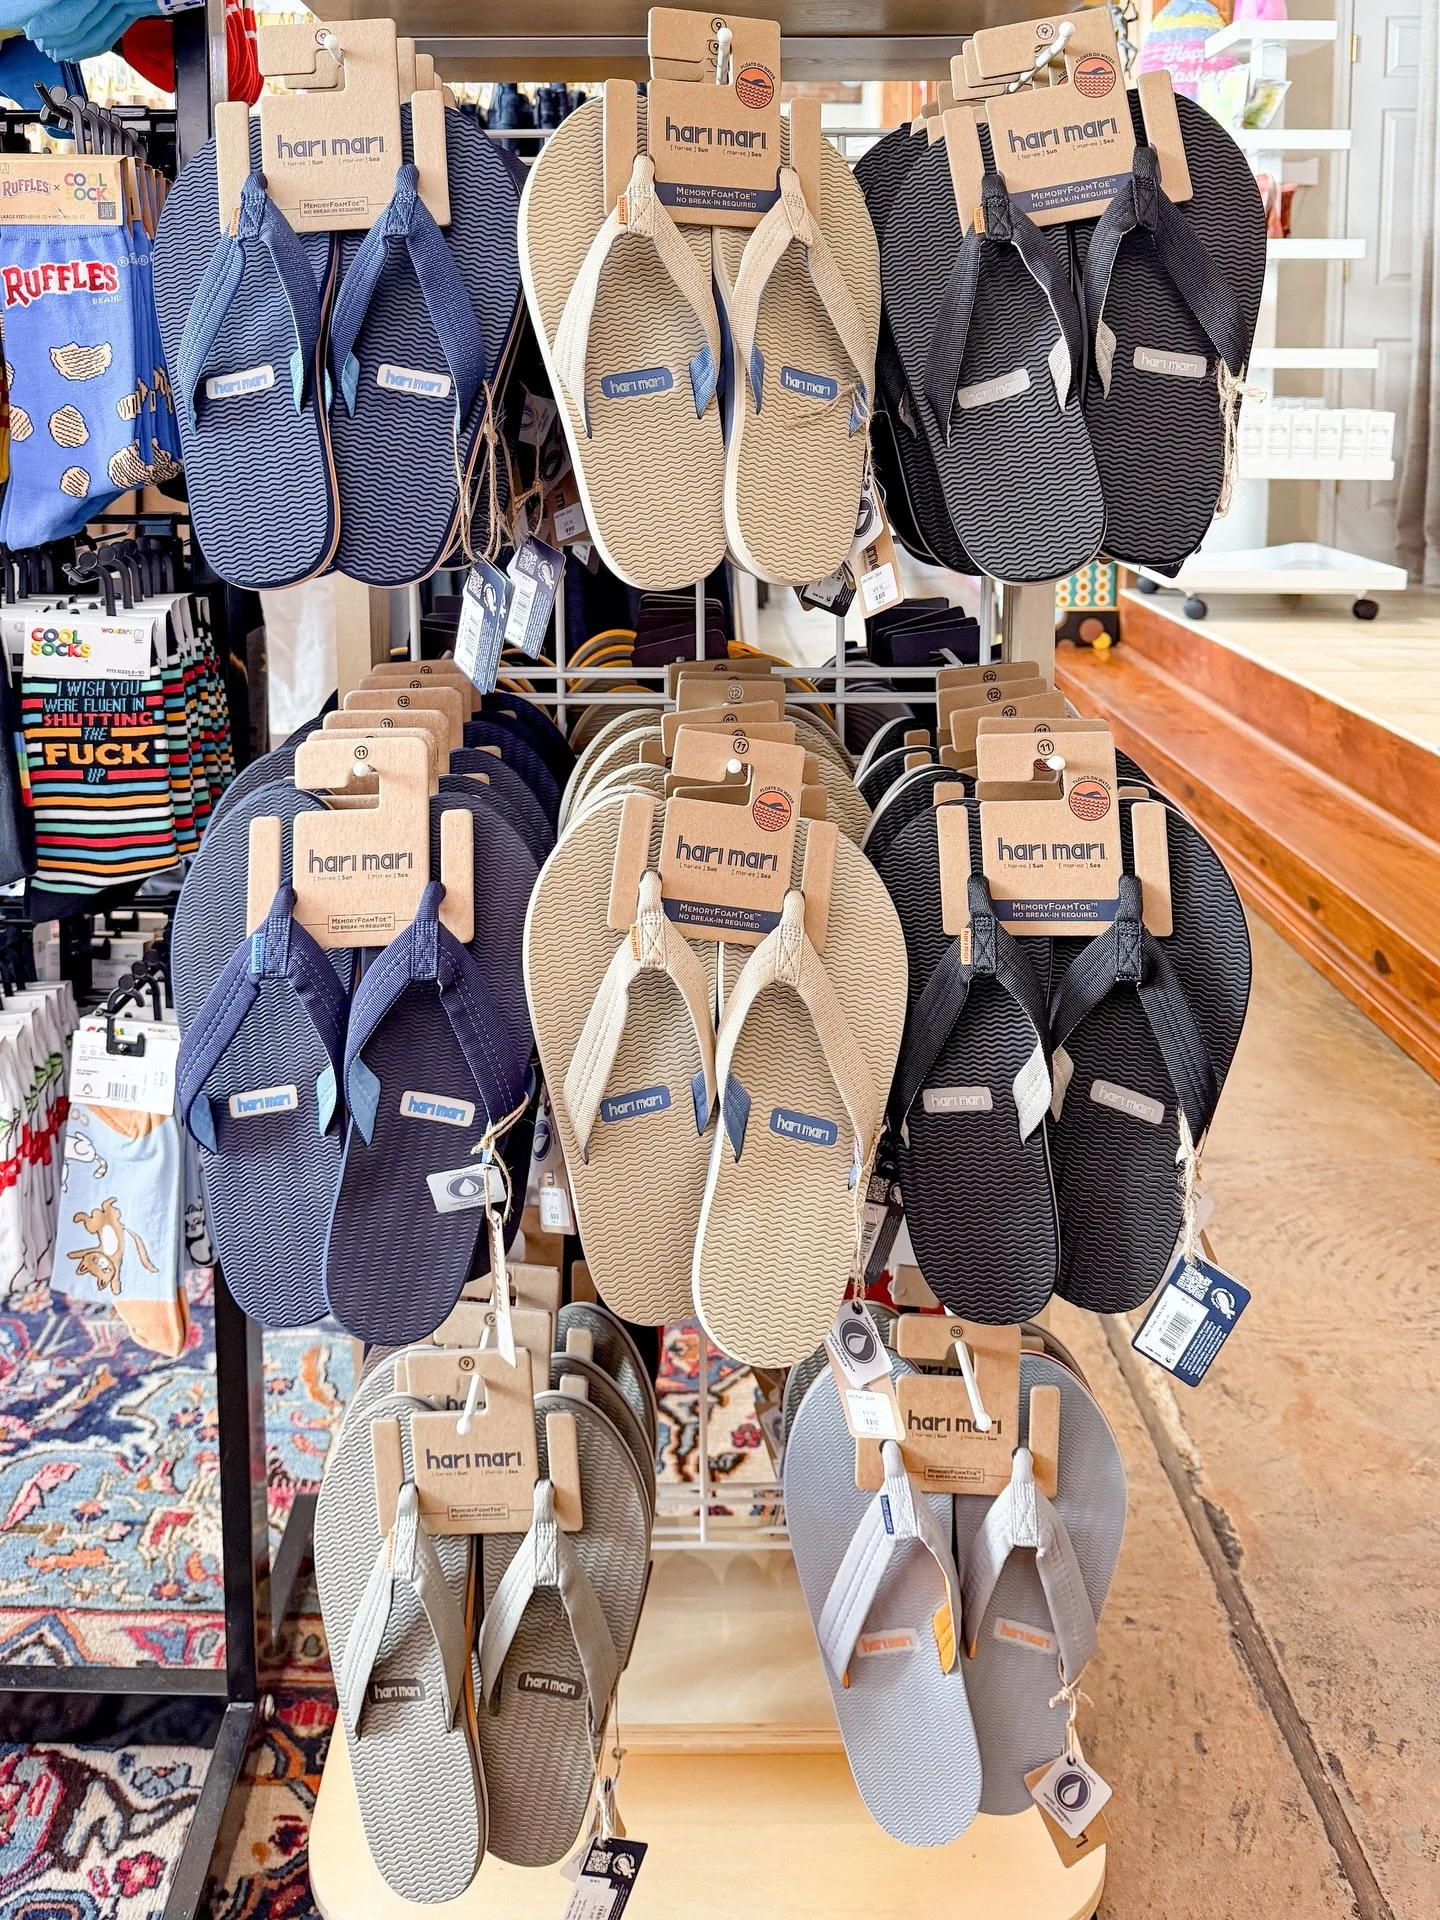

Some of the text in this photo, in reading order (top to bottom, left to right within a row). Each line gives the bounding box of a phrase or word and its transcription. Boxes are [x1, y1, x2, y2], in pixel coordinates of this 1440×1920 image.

[1075, 52, 1093, 64] FLOATS
[665, 116, 767, 149] hari mari
[1007, 117, 1118, 153] hari mari
[277, 134, 385, 159] hari mari
[2, 172, 108, 197] RUFFLES COOL
[65, 187, 116, 201] SOCKS
[676, 196, 687, 204] NO
[722, 199, 757, 209] REQUIRED
[1032, 200, 1044, 209] NO
[1081, 188, 1118, 200] REQUIRED
[2, 261, 118, 306] RUFFLES
[1141, 352, 1166, 367] hari
[384, 369, 409, 389] hari
[610, 375, 665, 394] hari mari
[785, 372, 831, 396] hari mari
[31, 627, 83, 645] COOL
[30, 642, 90, 659] SOCKS
[57, 680, 140, 697] I WISH YOU
[43, 696, 145, 713] WERE FLUENT IN
[43, 712, 153, 727] SHUTTING
[83, 726, 108, 741] THE
[44, 741, 150, 766] FUCK
[86, 768, 106, 783] UP
[675, 835, 778, 871] hari mari
[997, 837, 1106, 861] hari mari
[308, 849, 413, 873] hari mari
[678, 912, 690, 920] NO
[724, 918, 760, 929] REQUIRED
[237, 1093, 291, 1112] hari mari
[930, 1094, 958, 1107] hari
[1098, 1085, 1124, 1104] hari
[407, 1096, 466, 1121] hari mari
[608, 1094, 663, 1117] hari mari
[777, 1114, 830, 1141] hari mari
[907, 1409, 951, 1432] hari
[426, 1448, 522, 1470] hari mari
[374, 1684, 421, 1698] hari mari
[525, 1673, 576, 1695] hari mari
